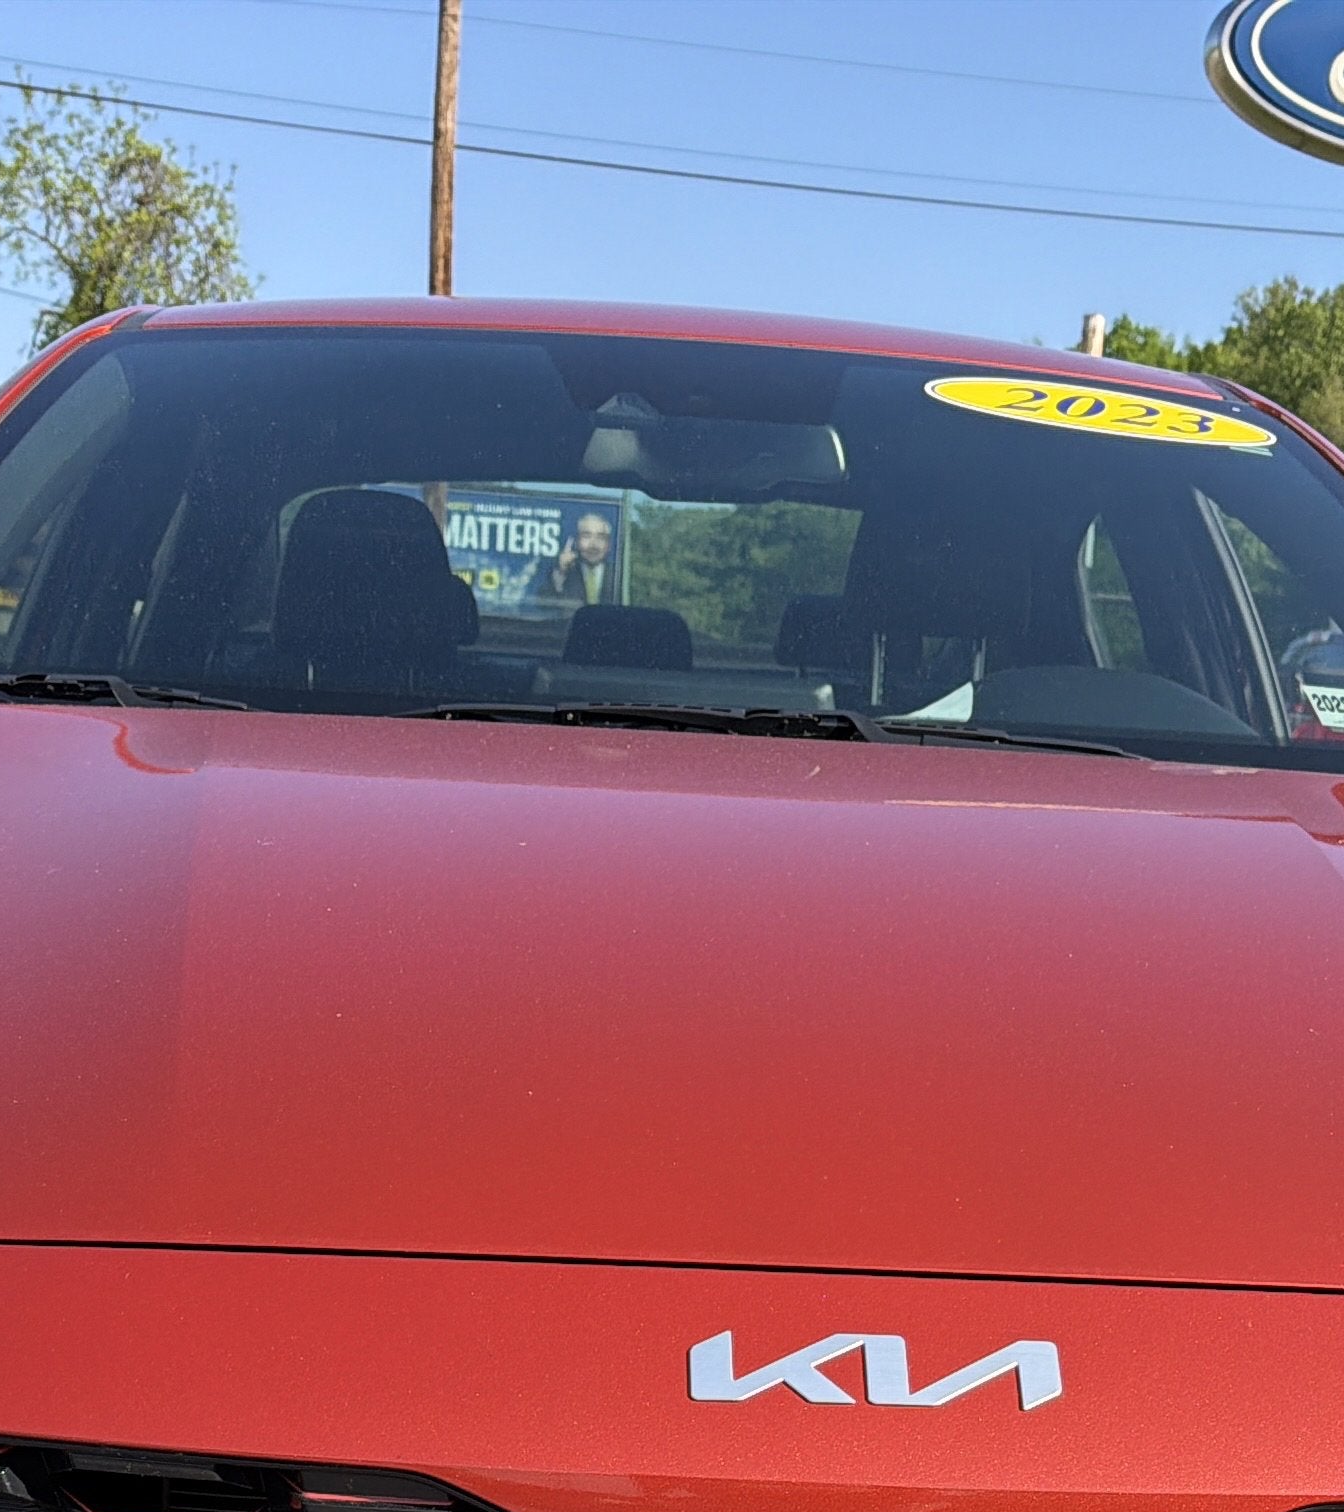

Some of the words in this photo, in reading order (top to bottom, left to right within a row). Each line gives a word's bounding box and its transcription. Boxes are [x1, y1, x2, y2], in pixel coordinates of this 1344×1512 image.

[994, 387, 1215, 434] 2023
[443, 513, 561, 557] MATTERS
[688, 1330, 1063, 1411] KIA
